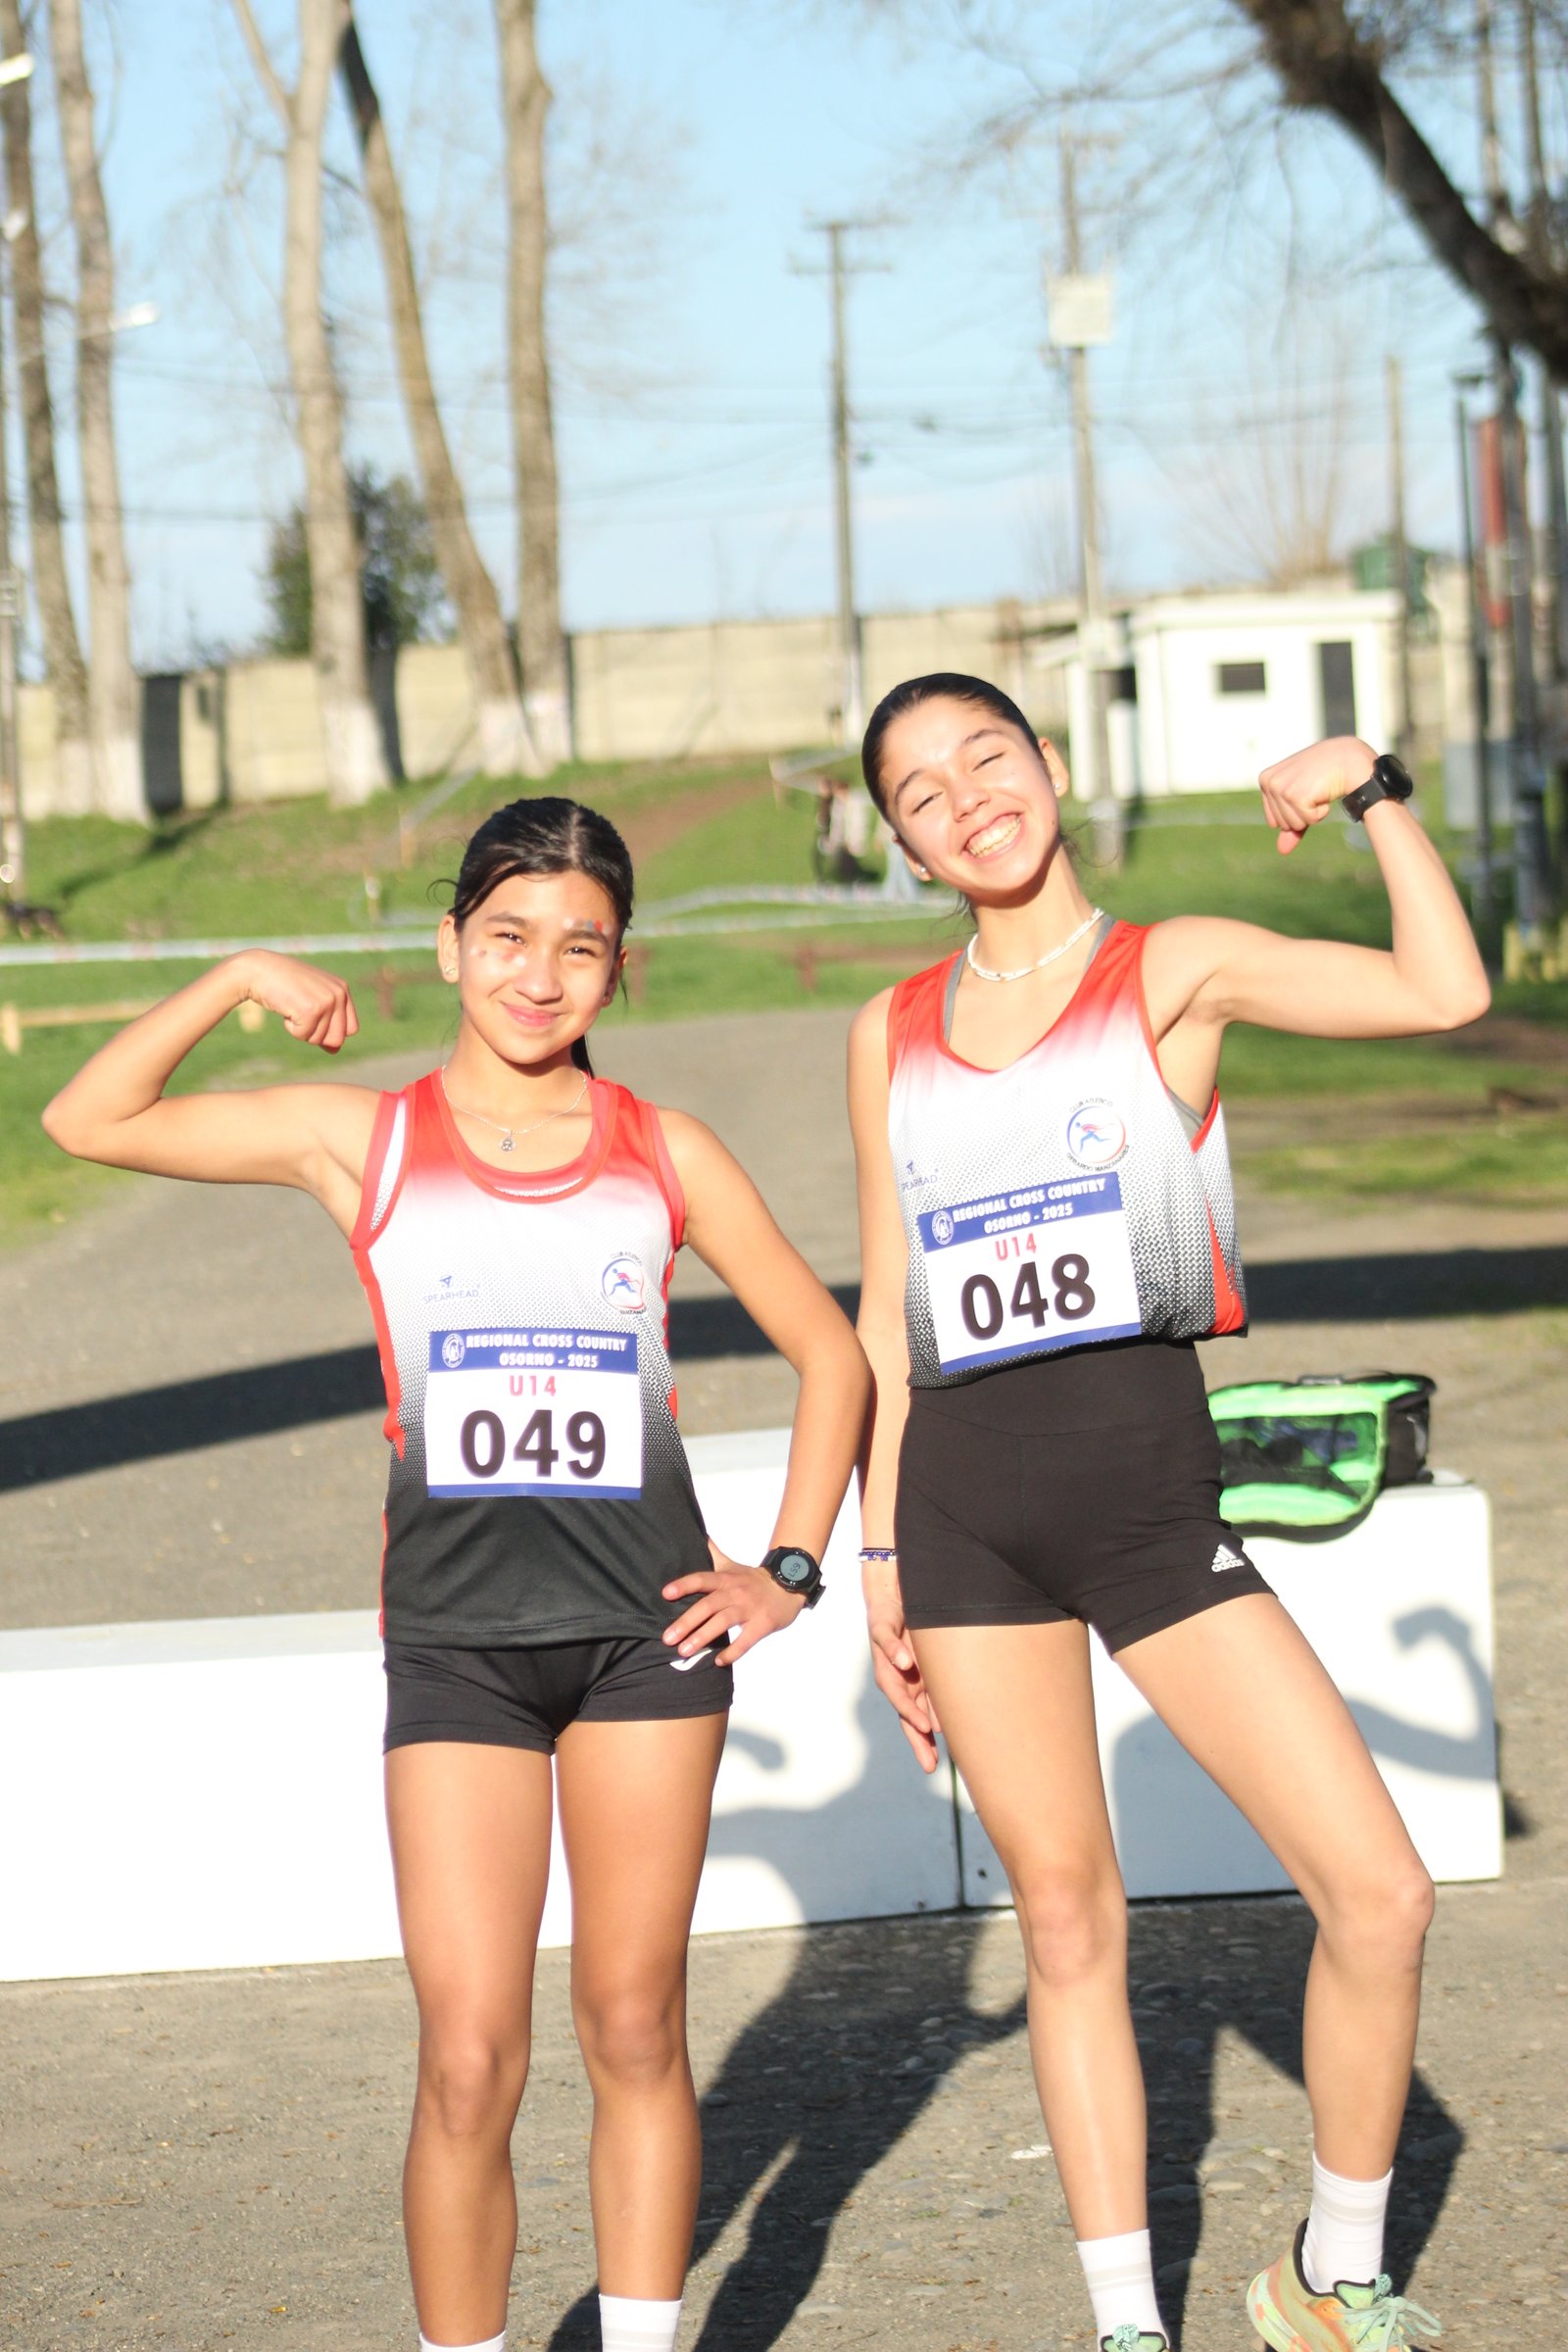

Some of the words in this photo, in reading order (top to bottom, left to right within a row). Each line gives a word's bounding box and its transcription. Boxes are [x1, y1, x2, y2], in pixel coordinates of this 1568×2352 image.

[953, 1200, 1007, 1223] REGIONAL
[1009, 1189, 1046, 1209] CROSS
[1048, 1178, 1105, 1200] COUNTRY
[984, 1211, 1031, 1234] OSORNO
[1042, 1202, 1073, 1221] 2025
[995, 1233, 1037, 1260] U14
[423, 1289, 479, 1304] SPEARHEAD
[960, 1253, 1096, 1341] 048
[466, 1334, 529, 1348] REGIONAL
[532, 1334, 572, 1348] CROSS
[576, 1336, 627, 1351] COUNTRY
[499, 1352, 555, 1366] OSORNO
[567, 1354, 598, 1368] 2025
[510, 1375, 557, 1396] U14
[460, 1409, 606, 1480] 049
